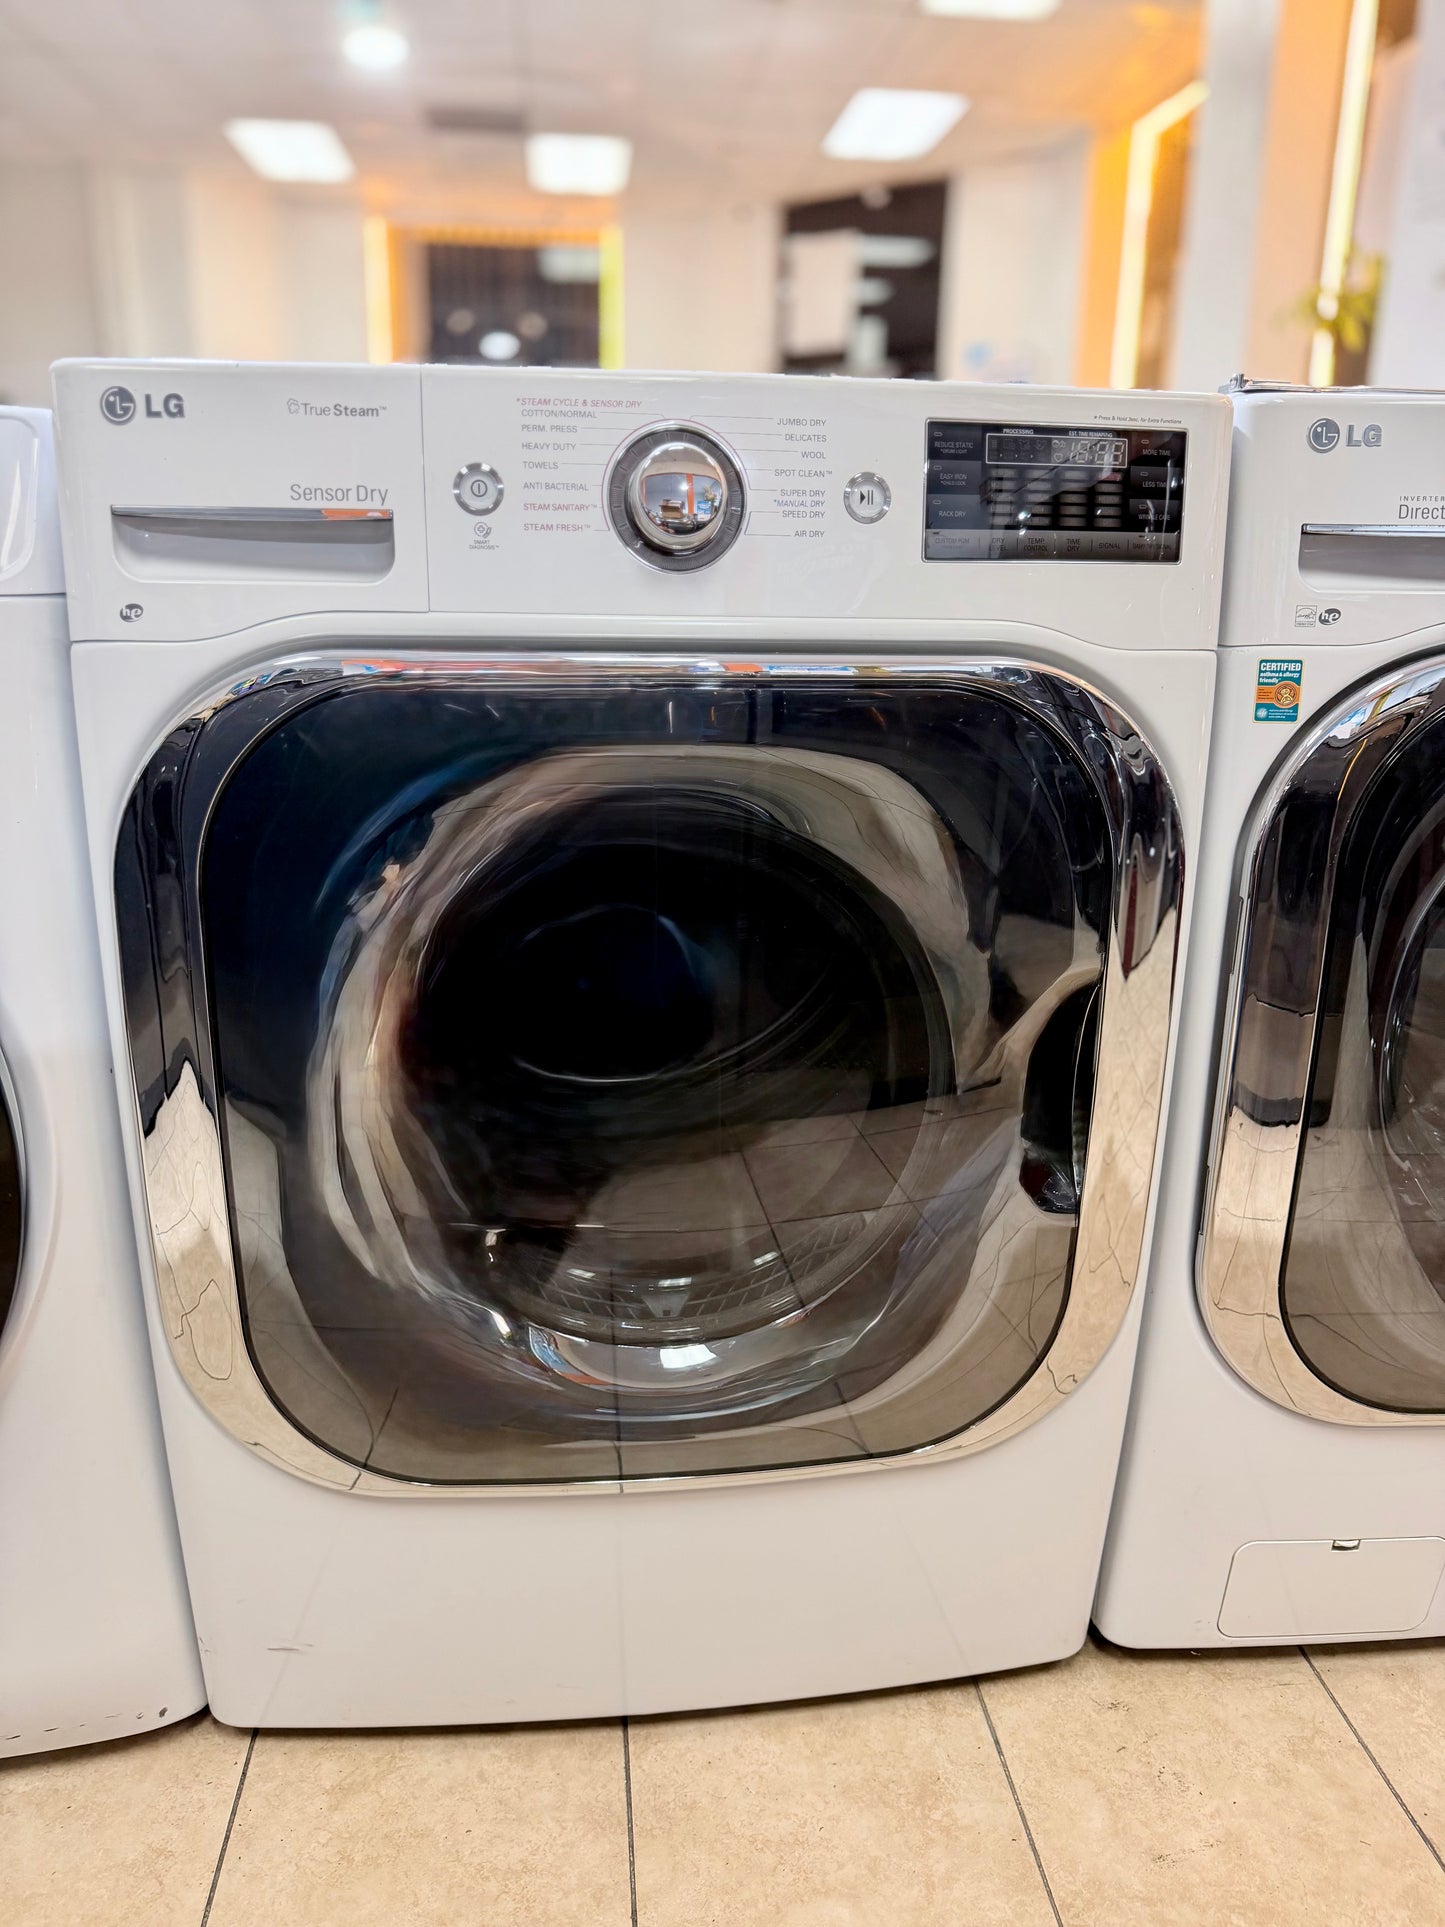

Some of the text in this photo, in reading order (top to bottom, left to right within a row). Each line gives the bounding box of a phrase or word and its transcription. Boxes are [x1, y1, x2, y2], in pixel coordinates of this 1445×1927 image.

[144, 393, 185, 418] LG
[553, 399, 579, 407] CYCLE
[581, 399, 588, 407] &
[591, 399, 624, 408] SENSOR
[625, 400, 642, 408] DRY
[521, 409, 598, 419] COTTON/NORMAL
[777, 418, 826, 427] JUMBO DRY
[521, 424, 578, 433] PERM. PRESS
[1002, 428, 1034, 436] PROCESSING
[784, 434, 827, 443] DELICATES
[1346, 424, 1382, 447] LG
[521, 443, 576, 451] HEAVY DUTY
[934, 441, 954, 449] REDUCE
[801, 451, 827, 459] WOOL
[523, 461, 559, 470] TOWELS
[774, 469, 796, 477] SPOT
[523, 482, 589, 491] ANTI BACTERIAL
[290, 484, 388, 506] Sensor Dry
[780, 489, 807, 497] SUPER
[523, 503, 551, 511] STEAM
[809, 500, 825, 508] DRY
[782, 510, 826, 519] SPEED DRY
[1398, 504, 1445, 520] Direct
[523, 523, 554, 532] STEAM
[794, 530, 808, 538] AIR
[121, 604, 143, 622] he
[1318, 608, 1341, 625] he
[1260, 662, 1302, 671] CERTIFIED
